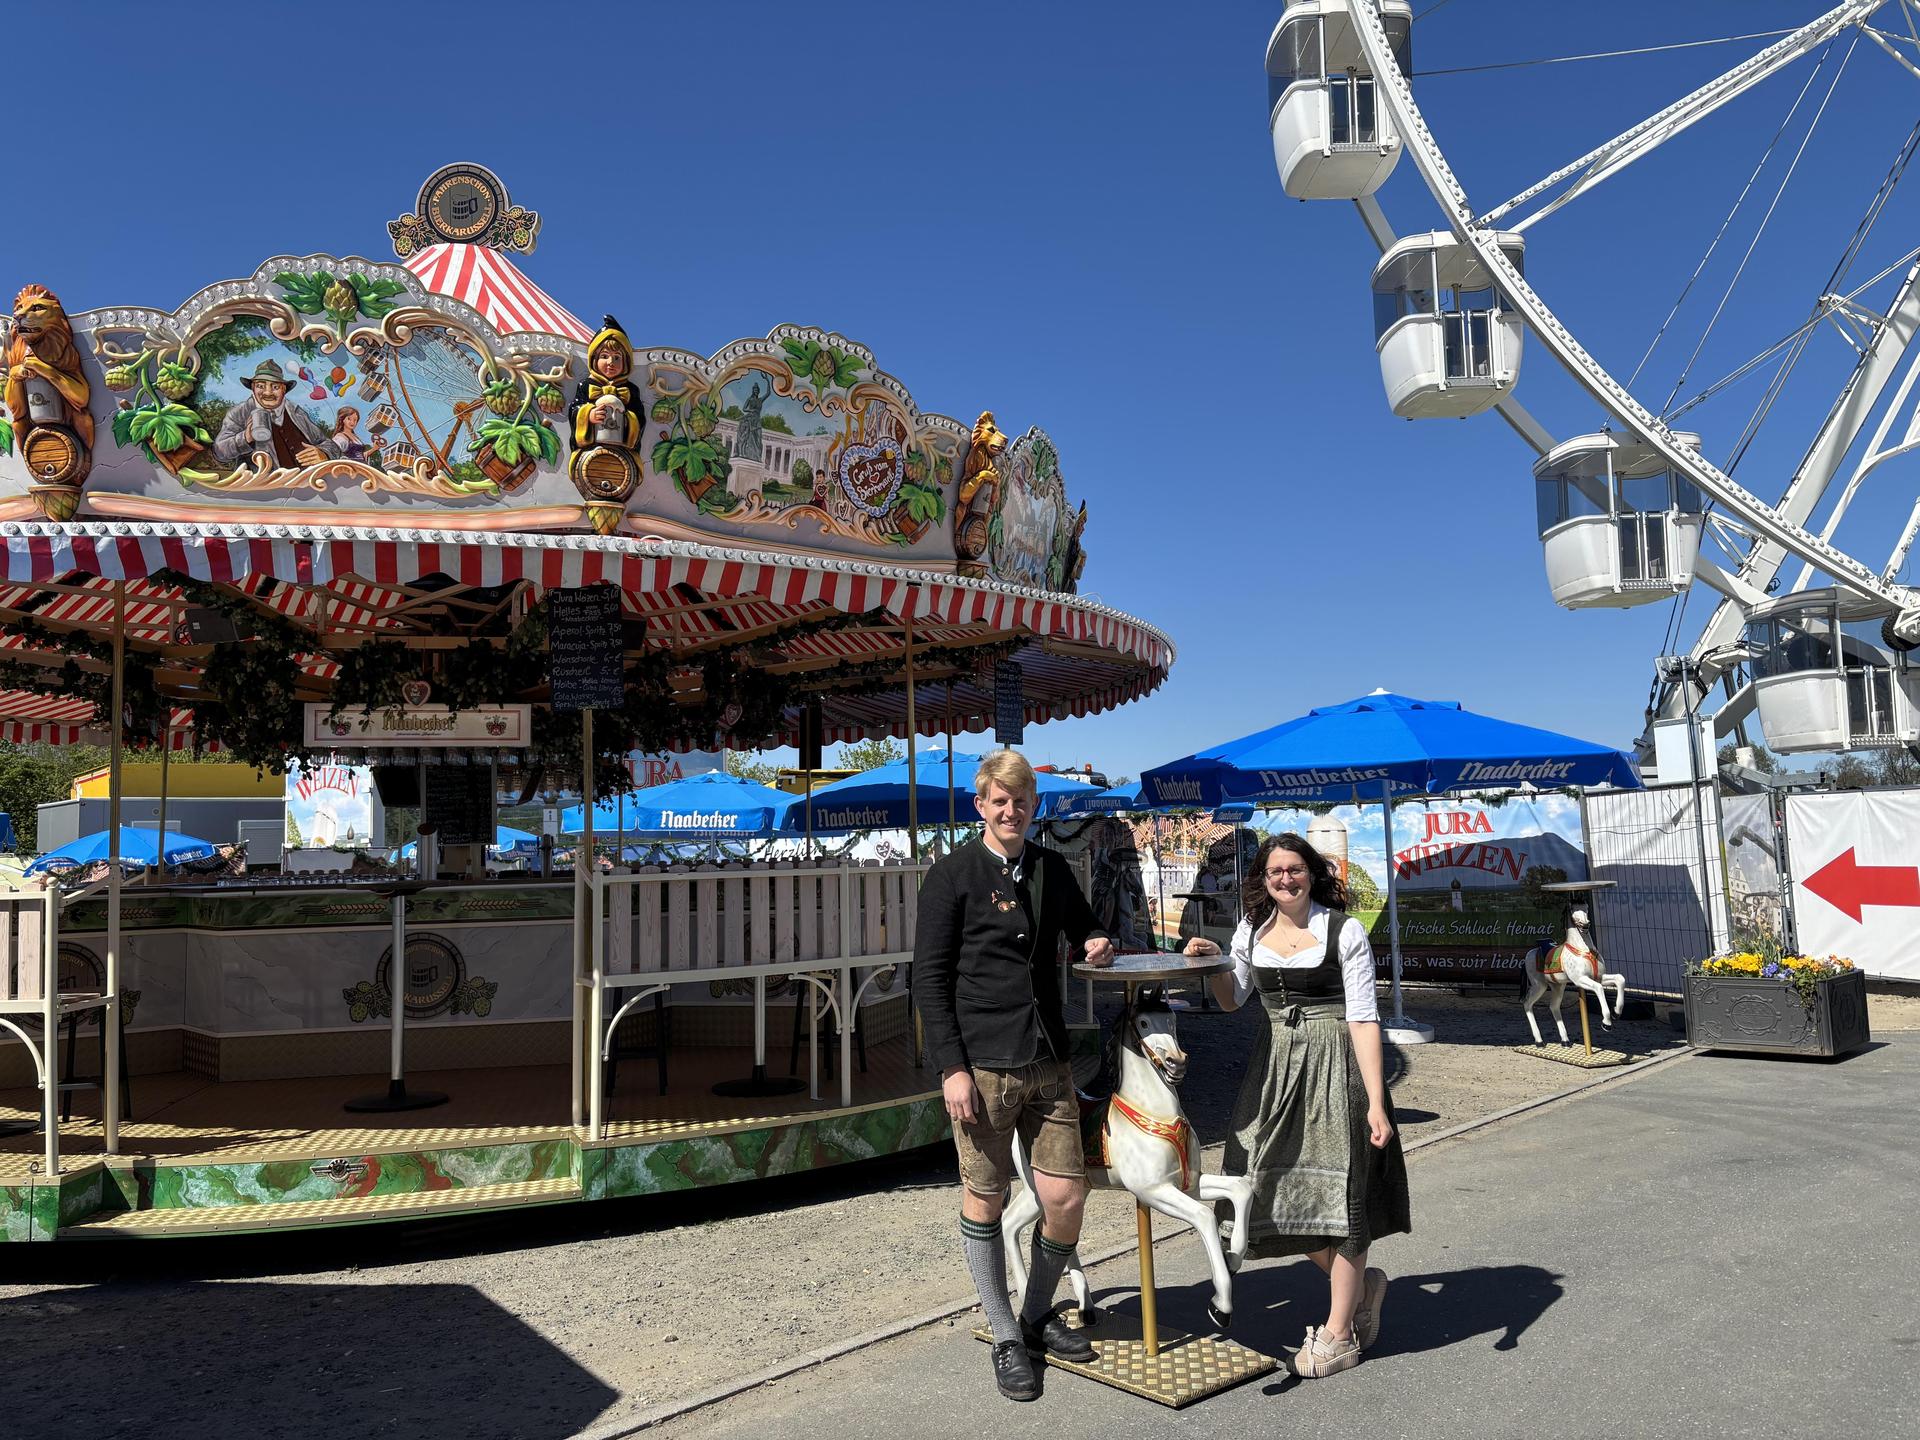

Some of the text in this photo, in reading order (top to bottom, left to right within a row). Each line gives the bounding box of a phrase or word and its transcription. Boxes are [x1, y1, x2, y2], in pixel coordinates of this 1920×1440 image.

[433, 176, 490, 203] FAHRENSCHON
[432, 204, 492, 236] BIERKARUSSELL
[553, 591, 573, 604] Jura
[553, 605, 581, 618] Helles
[624, 757, 683, 790] URA
[1259, 767, 1389, 788] Naabecker
[1457, 758, 1576, 781] Naabecker
[295, 766, 361, 801] WEIZEN
[1153, 774, 1202, 801] Naabecker
[660, 810, 738, 829] Naabecker
[817, 805, 889, 828] Naabecker
[1420, 810, 1495, 843] JURA
[1392, 841, 1529, 881] WEIZEN
[1405, 919, 1446, 937] frische
[1448, 919, 1500, 935] Schluck
[1506, 920, 1555, 935] Heimat
[1375, 953, 1392, 967] uf
[1426, 956, 1454, 968] was
[1459, 954, 1487, 968] wir
